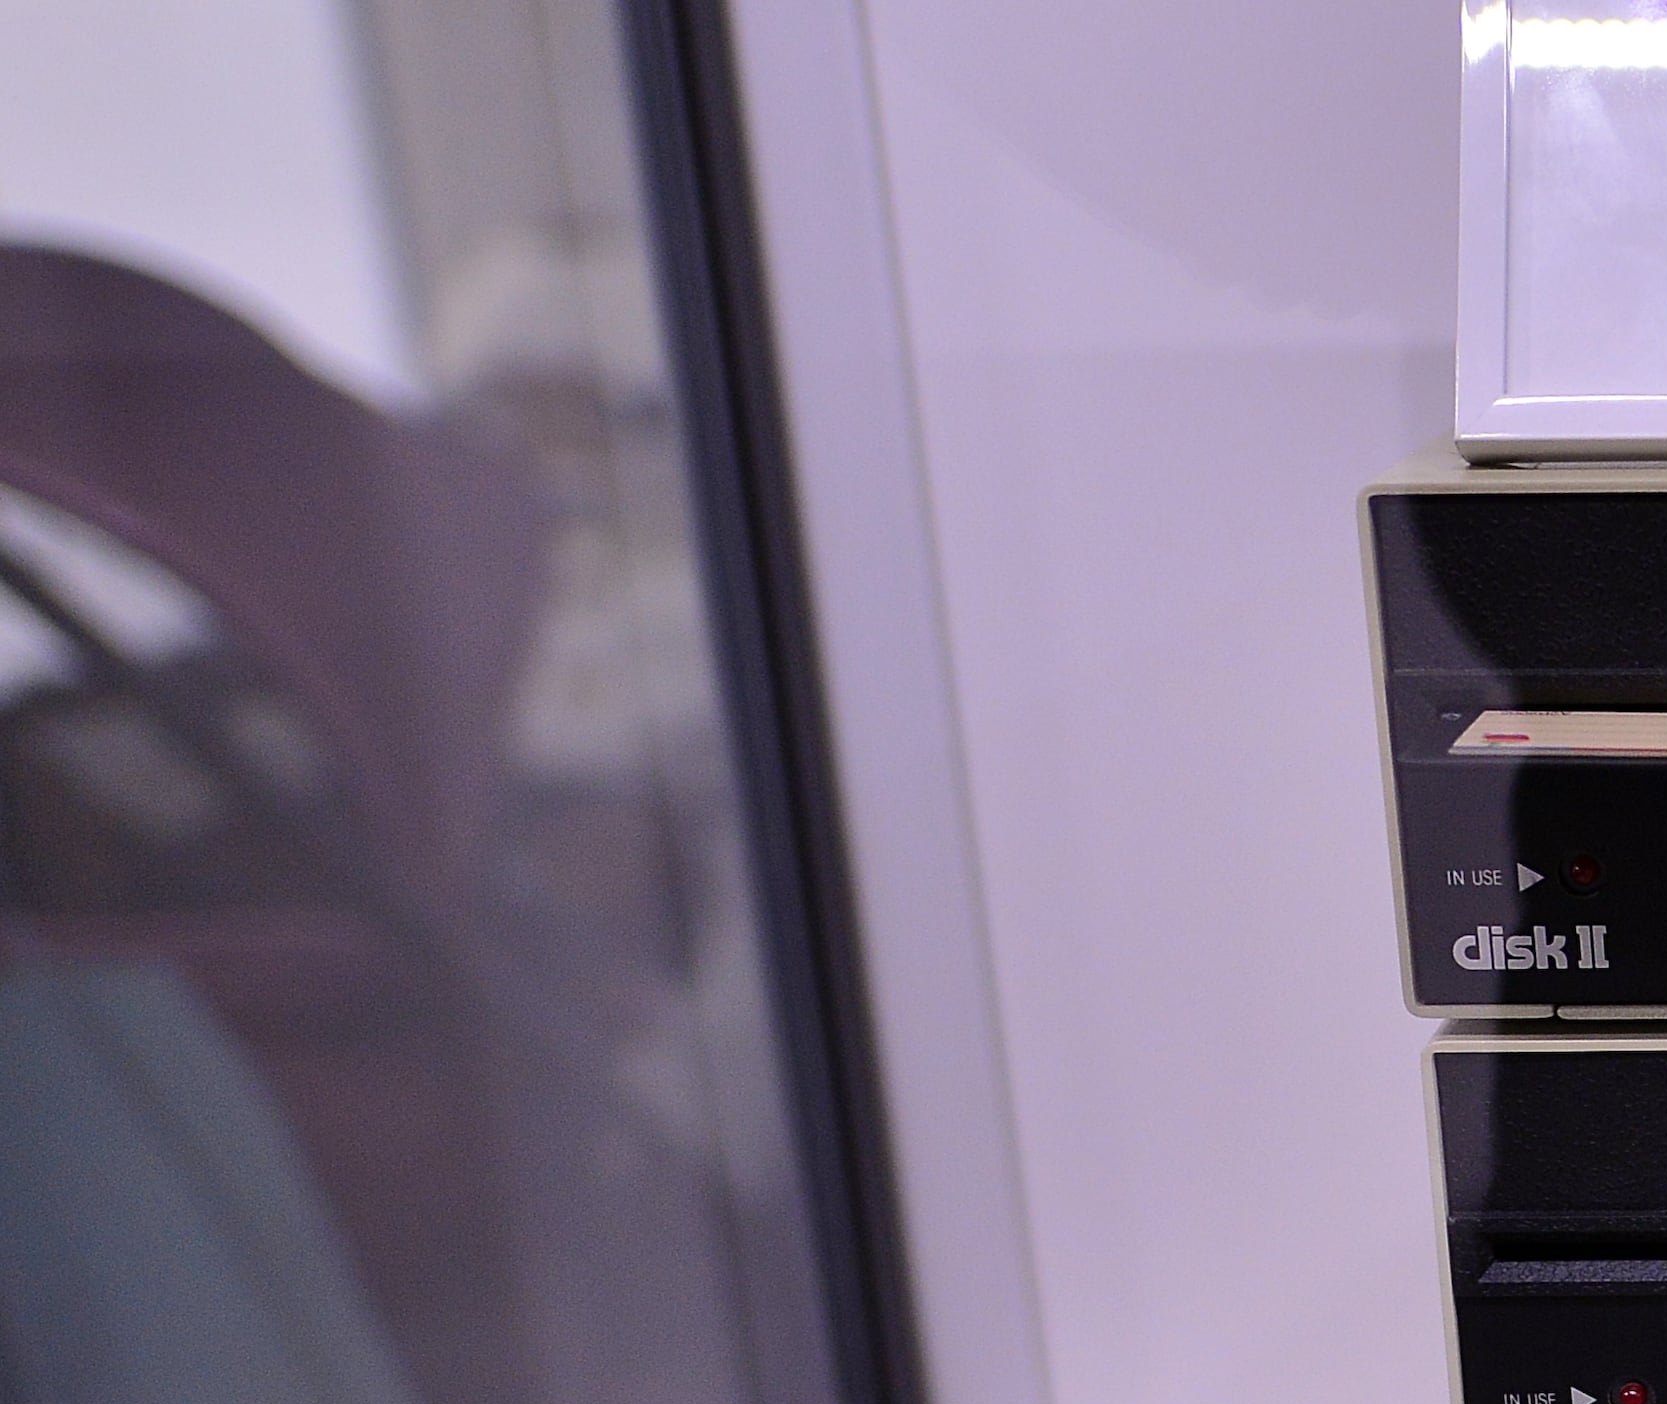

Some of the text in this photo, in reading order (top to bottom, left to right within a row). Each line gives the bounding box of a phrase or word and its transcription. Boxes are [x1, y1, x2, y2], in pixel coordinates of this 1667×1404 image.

[1446, 869, 1503, 886] IN USE
[1452, 925, 1569, 971] disk
